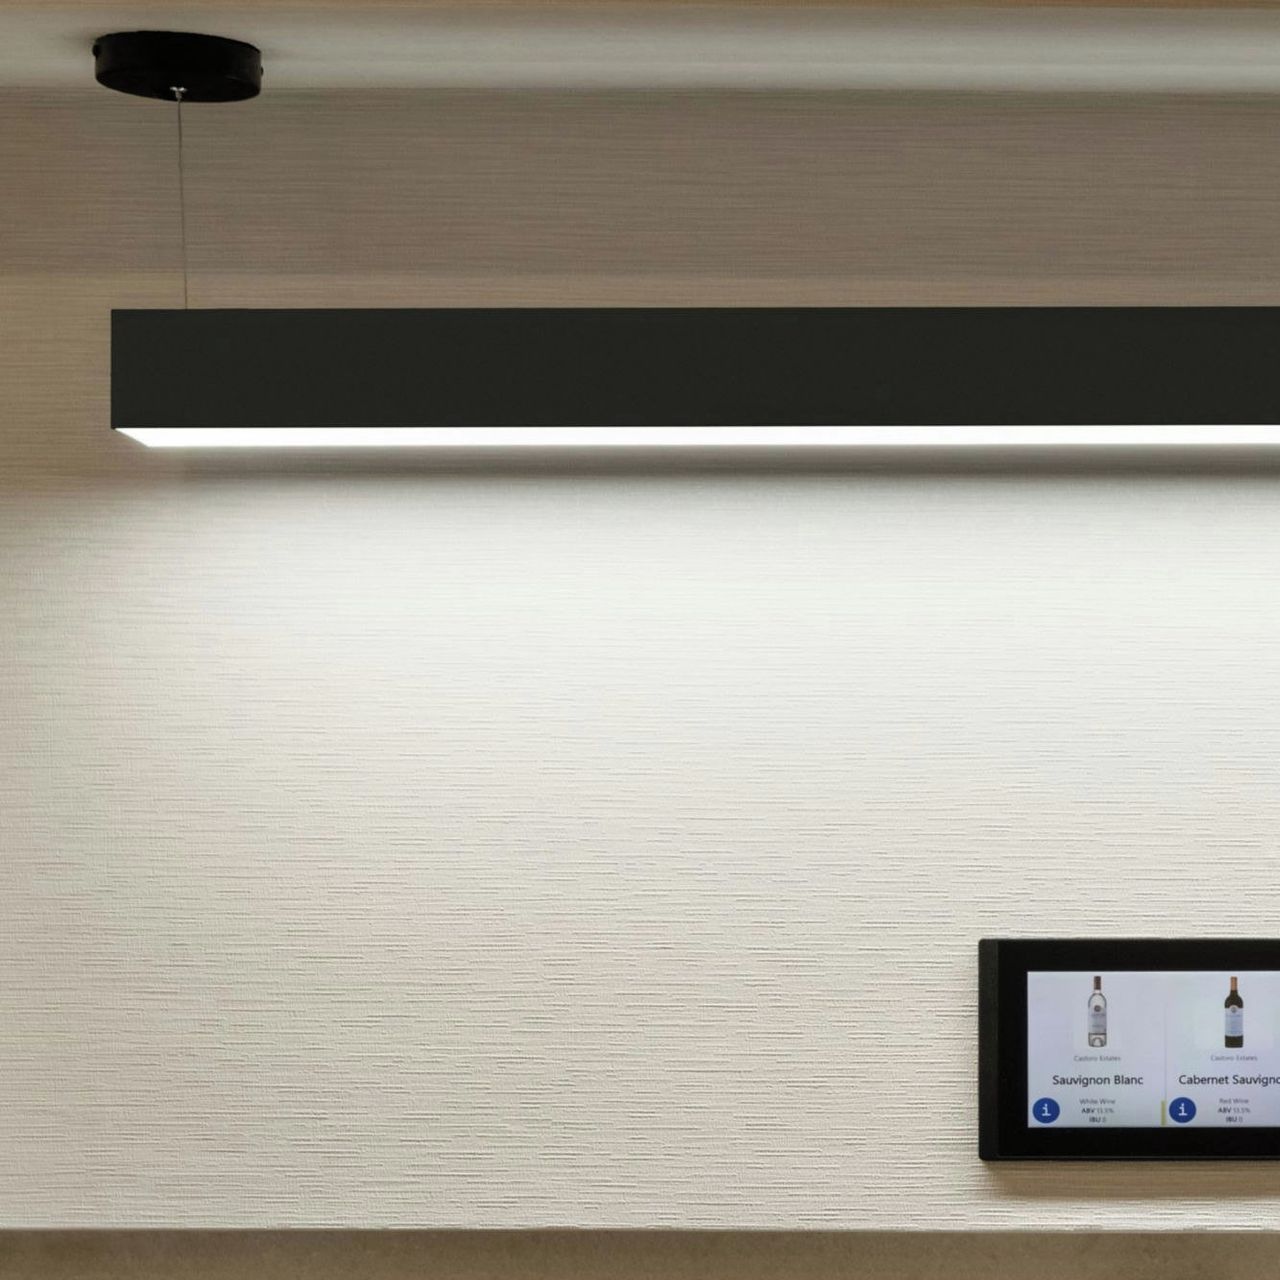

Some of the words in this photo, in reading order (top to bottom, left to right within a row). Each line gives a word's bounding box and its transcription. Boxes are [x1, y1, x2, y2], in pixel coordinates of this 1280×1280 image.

[1052, 1075, 1110, 1087] Sauvignon
[1114, 1075, 1143, 1085] Blanc
[1179, 1075, 1229, 1085] Cabernet
